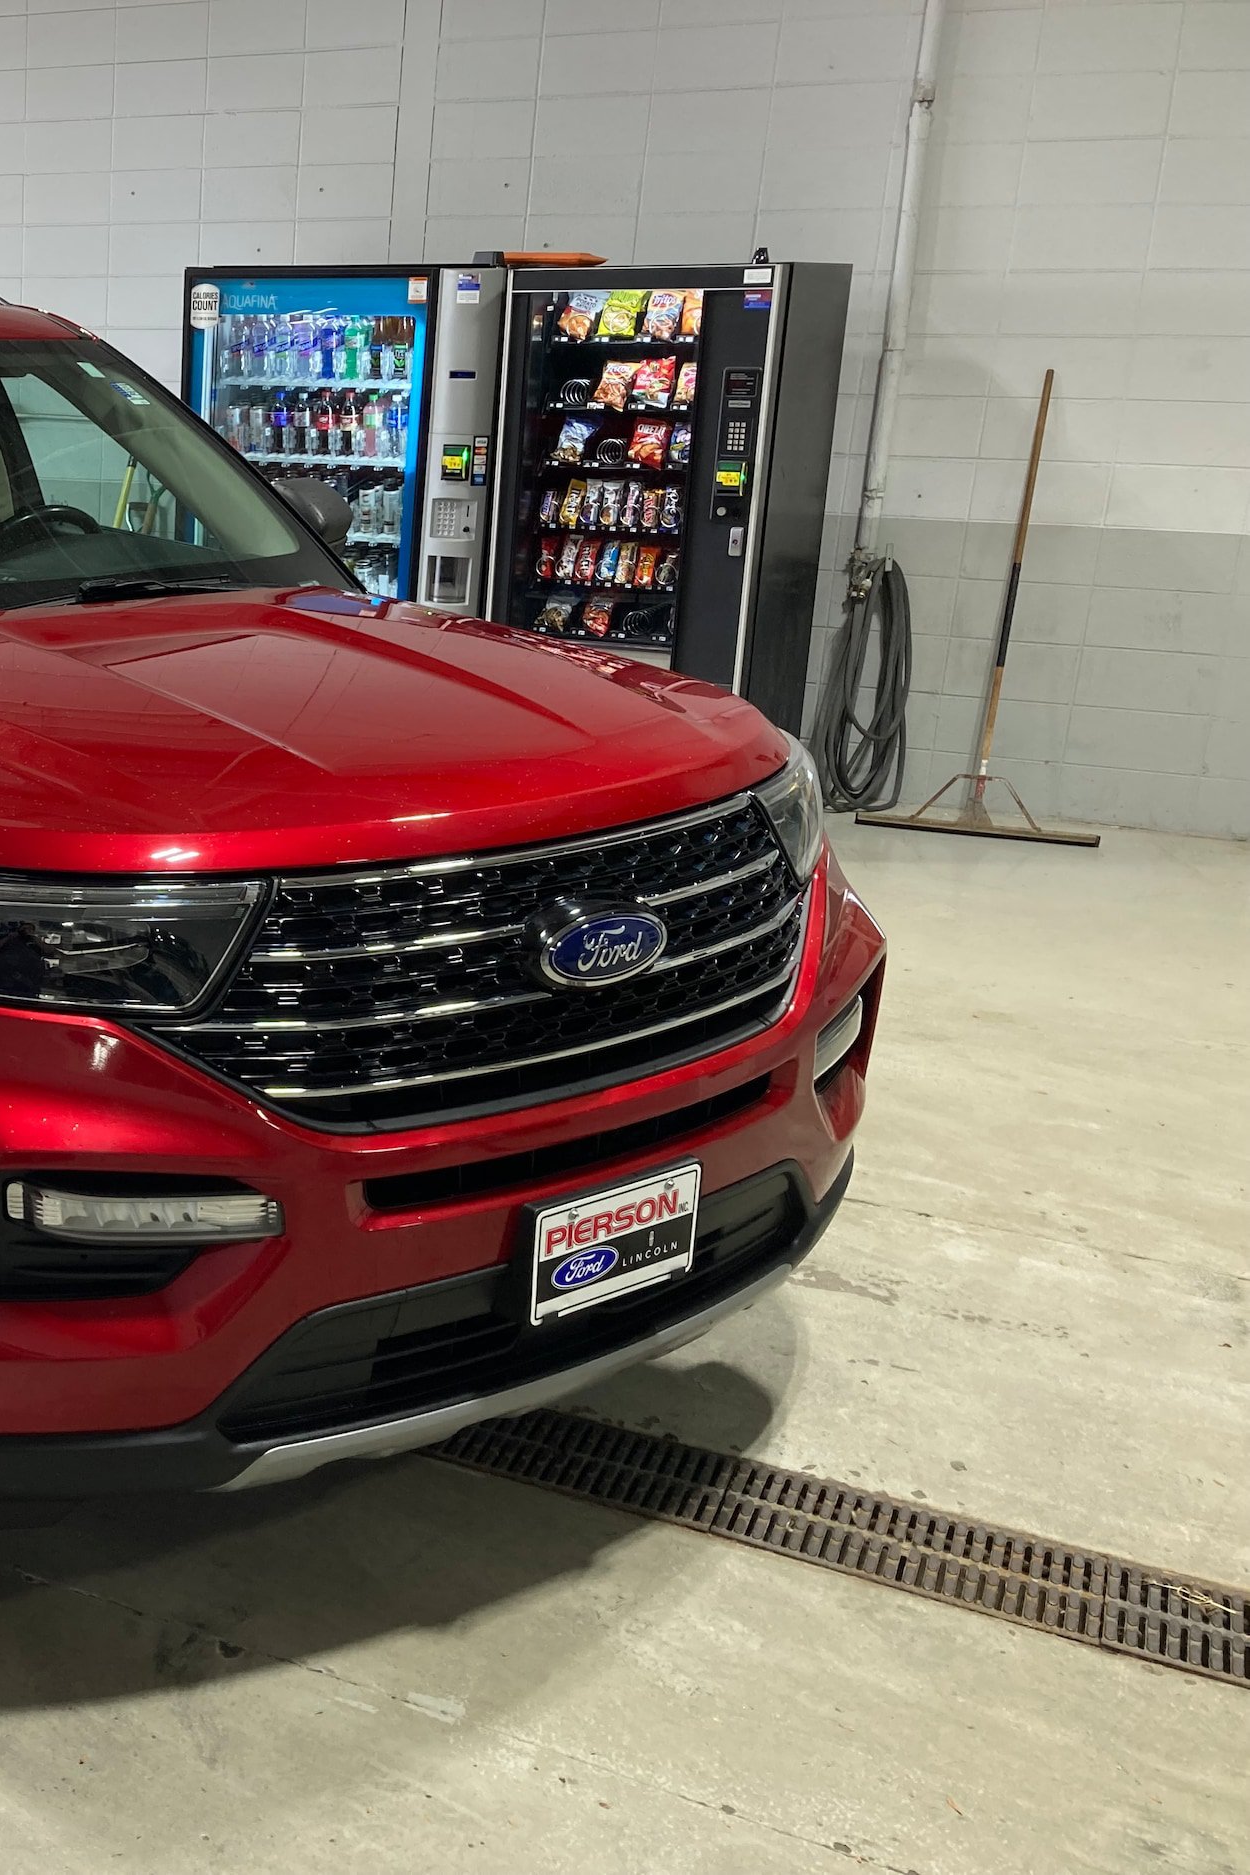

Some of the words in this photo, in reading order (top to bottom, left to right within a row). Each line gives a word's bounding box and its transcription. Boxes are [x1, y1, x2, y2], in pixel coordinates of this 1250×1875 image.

[192, 292, 218, 300] CALORIES
[222, 294, 278, 310] AQUAFINA
[192, 300, 218, 311] COUNT
[577, 925, 643, 972] Ford
[678, 1201, 690, 1214] INC.
[544, 1189, 680, 1257] PIERSON
[565, 1253, 604, 1283] Ford
[622, 1241, 679, 1267] LINCOLN
